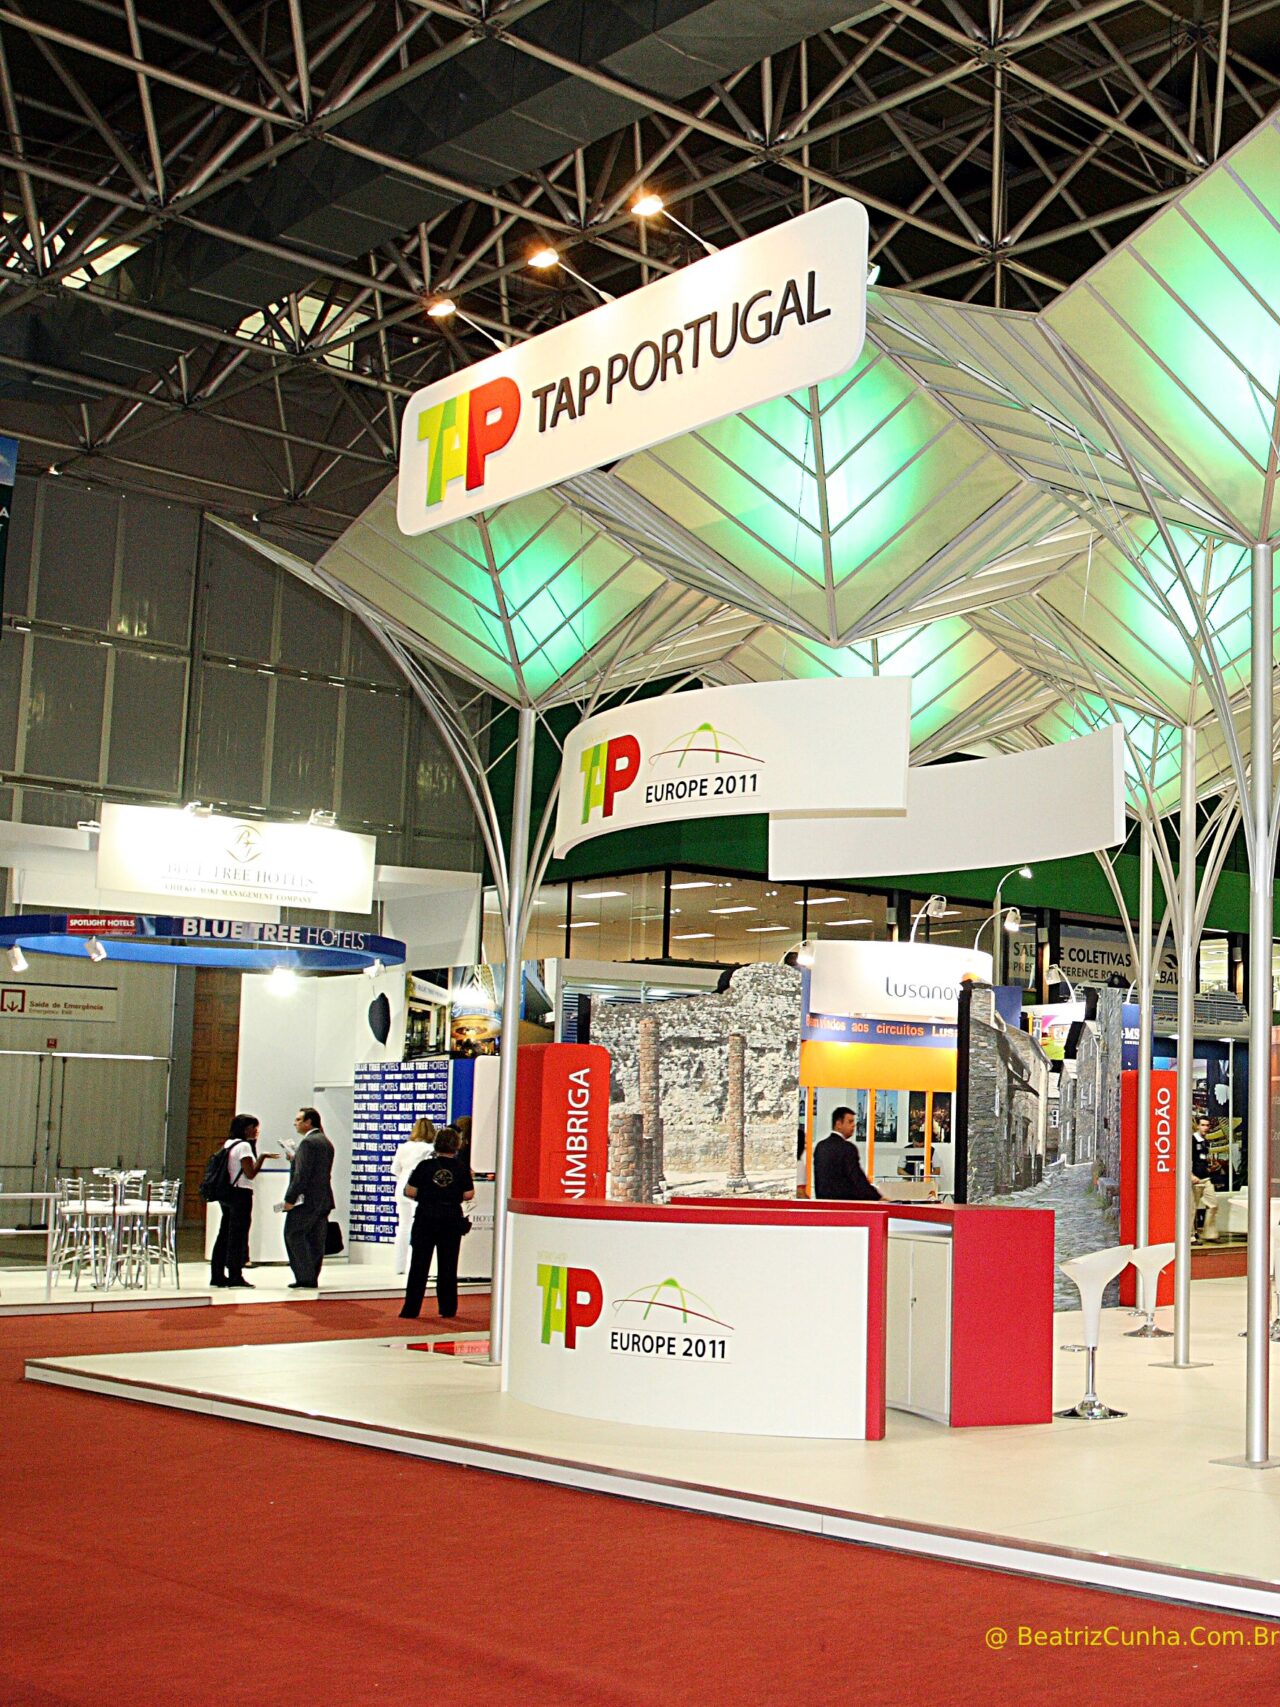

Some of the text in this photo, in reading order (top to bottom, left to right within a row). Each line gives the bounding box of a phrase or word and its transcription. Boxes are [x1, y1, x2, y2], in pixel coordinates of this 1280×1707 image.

[532, 270, 831, 433] TAP PORTUGAL
[418, 376, 521, 506] TAP
[580, 734, 641, 825] TAP
[645, 773, 757, 804] EUROPE 2011
[107, 919, 135, 927] HOTELS
[182, 918, 365, 950] BLUE TREE HOTELS
[1013, 942, 1036, 957] SAL
[1068, 948, 1132, 967] COLETIVAS
[1061, 966, 1099, 979] FERENCE
[852, 1023, 869, 1032] aos
[876, 1022, 924, 1036] circuitos
[932, 1025, 958, 1038] Lus
[561, 1068, 591, 1199] NÍMBRIGA
[1156, 1087, 1171, 1173] PIÓDÃO
[537, 1264, 603, 1350] TAP
[610, 1331, 726, 1359] EUROPE 2011
